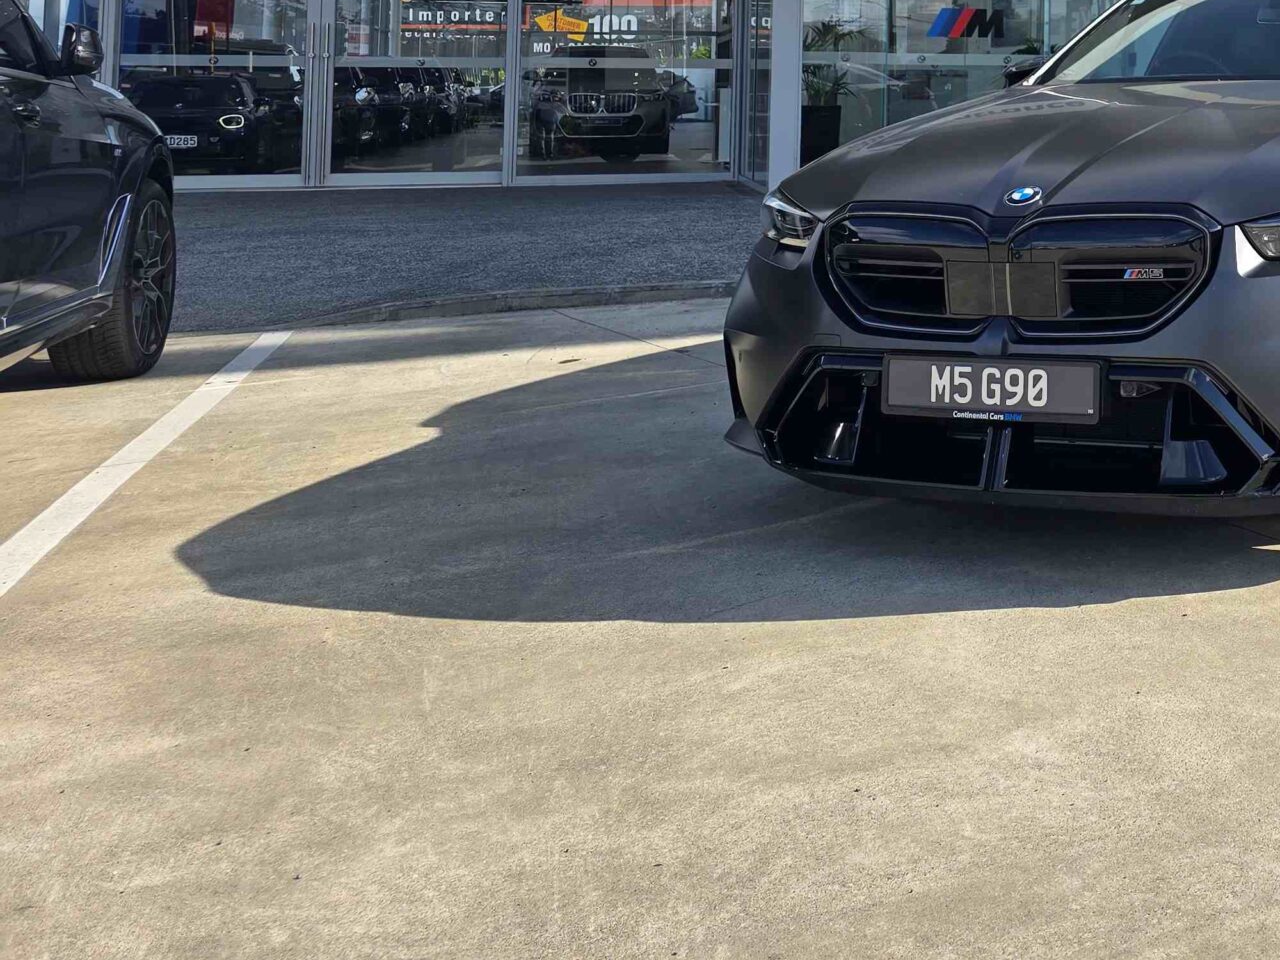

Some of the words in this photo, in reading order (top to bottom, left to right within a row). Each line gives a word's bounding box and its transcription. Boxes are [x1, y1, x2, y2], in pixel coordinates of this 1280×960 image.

[165, 136, 197, 146] D285
[1136, 268, 1164, 279] M5
[930, 365, 973, 404] M5
[981, 367, 1048, 407] G90
[952, 410, 989, 420] Continental
[989, 413, 1004, 421] Cars
